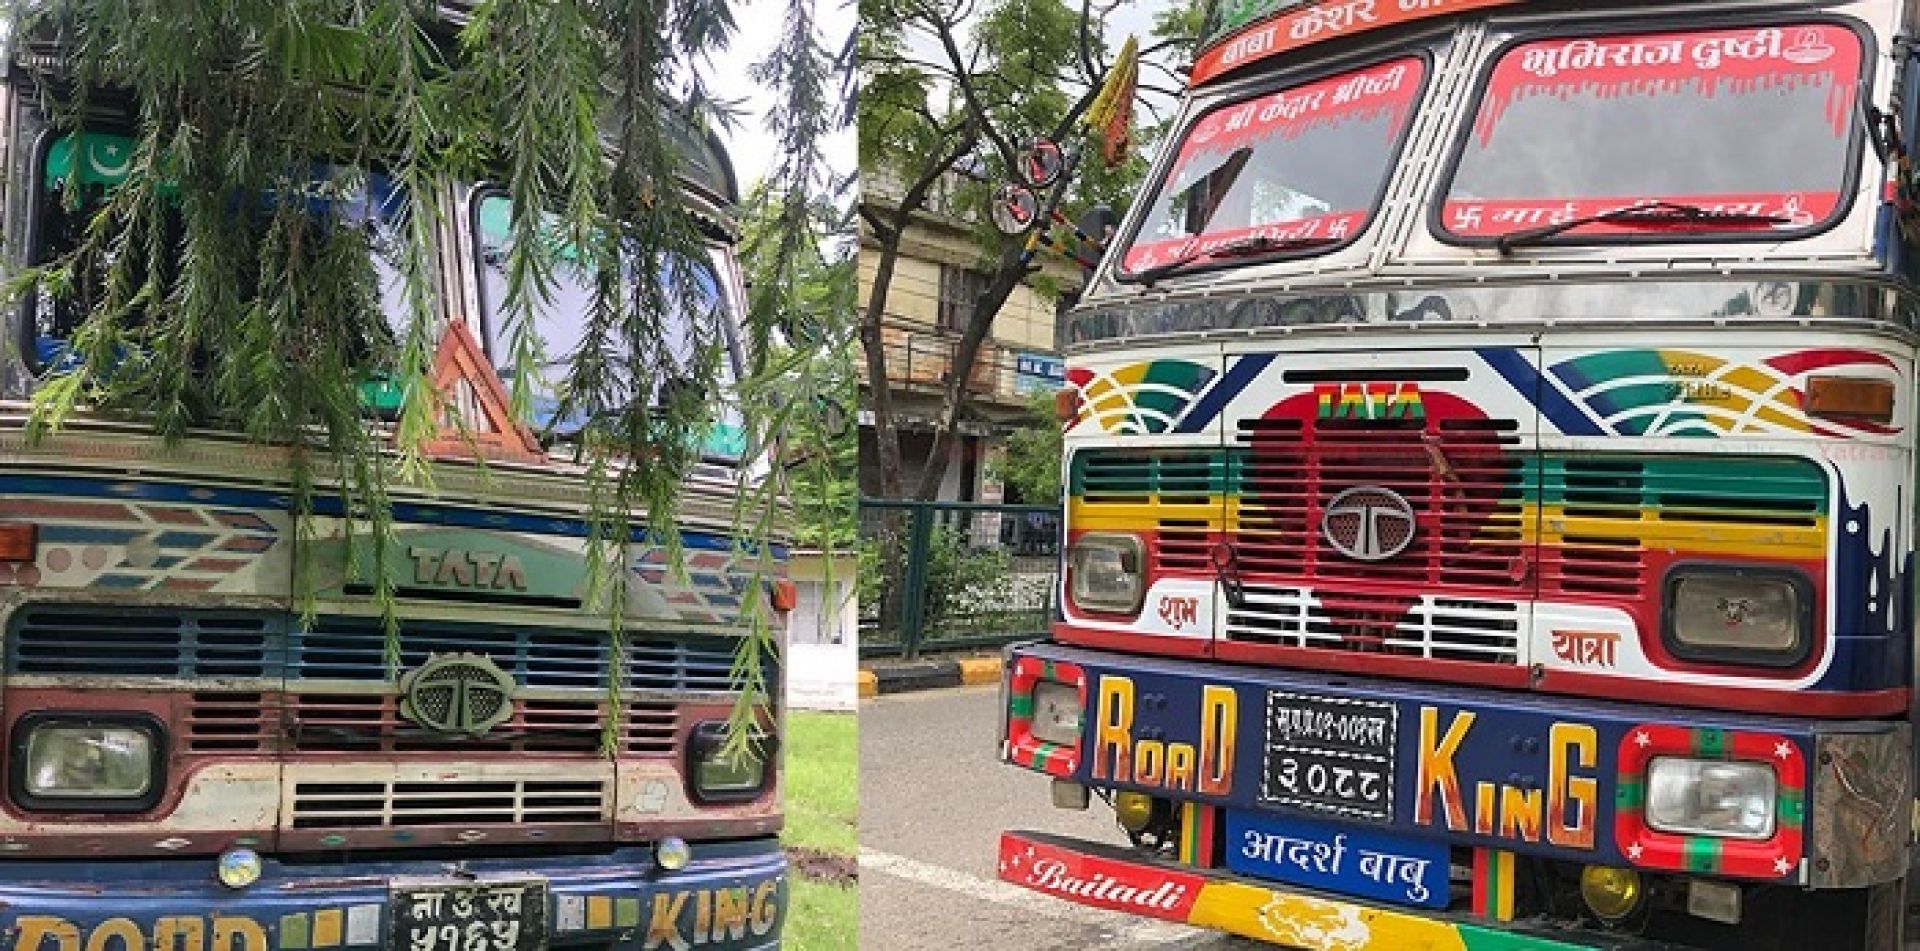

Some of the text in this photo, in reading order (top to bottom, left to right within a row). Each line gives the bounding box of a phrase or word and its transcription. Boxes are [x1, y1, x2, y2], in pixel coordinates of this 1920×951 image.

[1313, 383, 1426, 422] TATA
[407, 544, 528, 592] TATA
[1157, 594, 1200, 631] शुभ
[1551, 629, 1622, 667] यात्रा
[1026, 856, 1187, 910] Baitadi
[1242, 829, 1432, 902] आदर्श बाबु
[645, 882, 778, 951] KING
